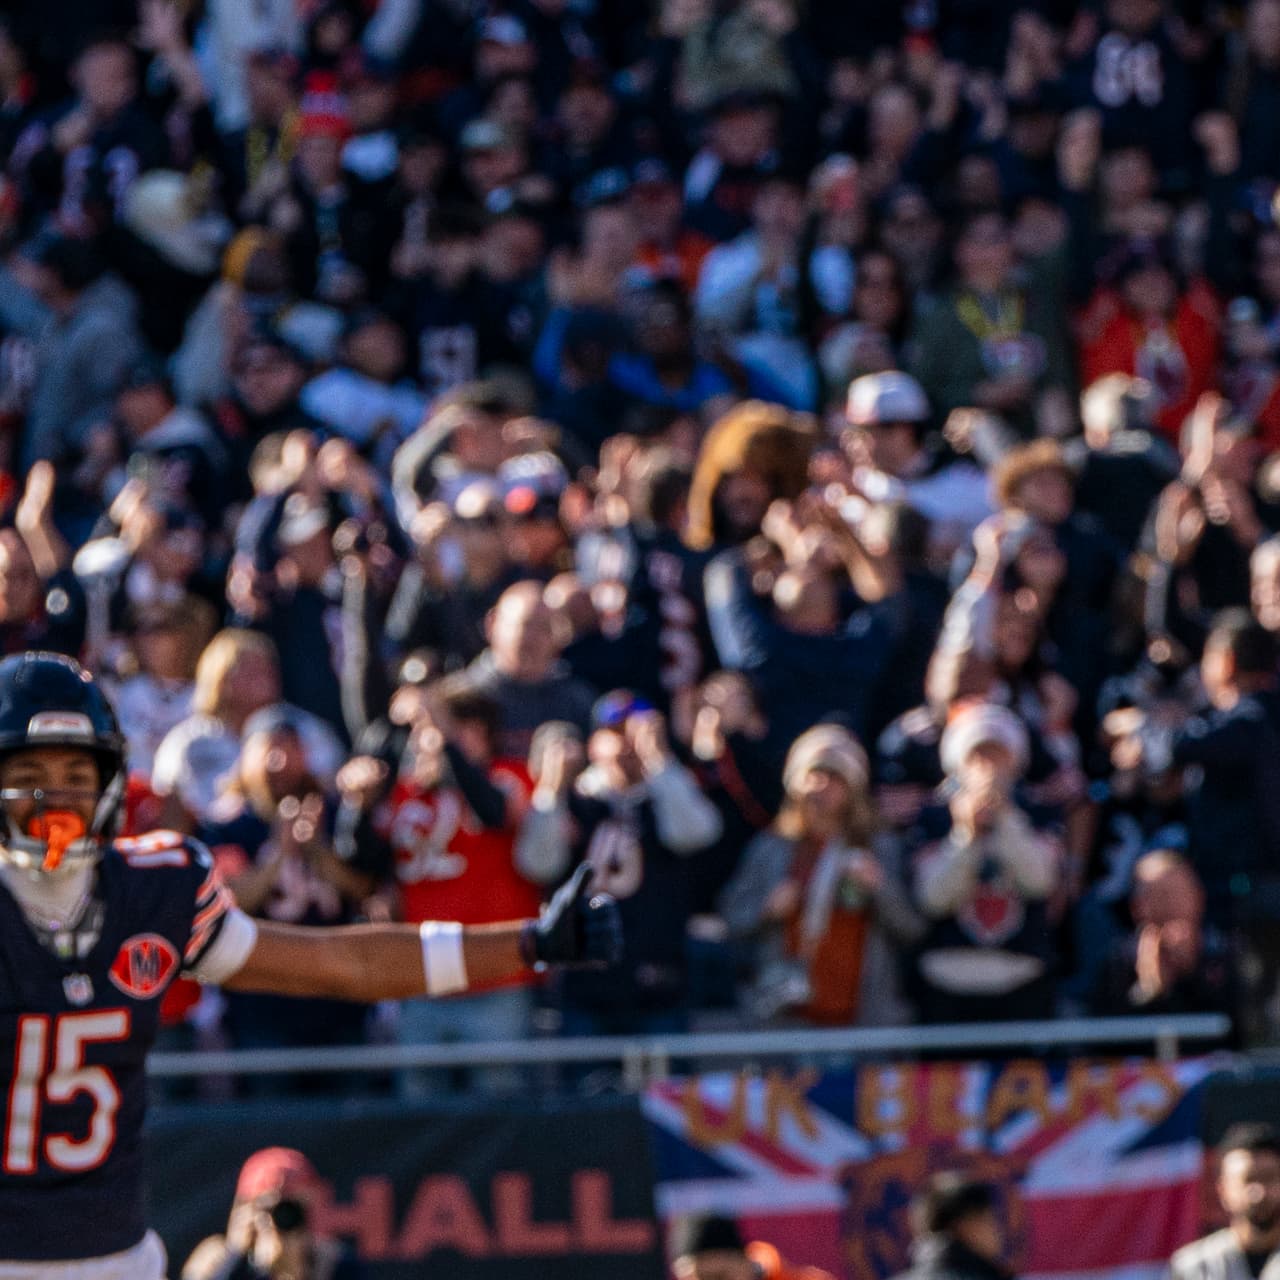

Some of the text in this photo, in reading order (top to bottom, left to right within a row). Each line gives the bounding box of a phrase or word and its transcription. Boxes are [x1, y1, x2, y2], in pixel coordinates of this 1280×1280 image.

[2, 1007, 132, 1176] 15
[682, 1056, 1180, 1145] UK BEARS
[312, 1171, 652, 1258] HALL
